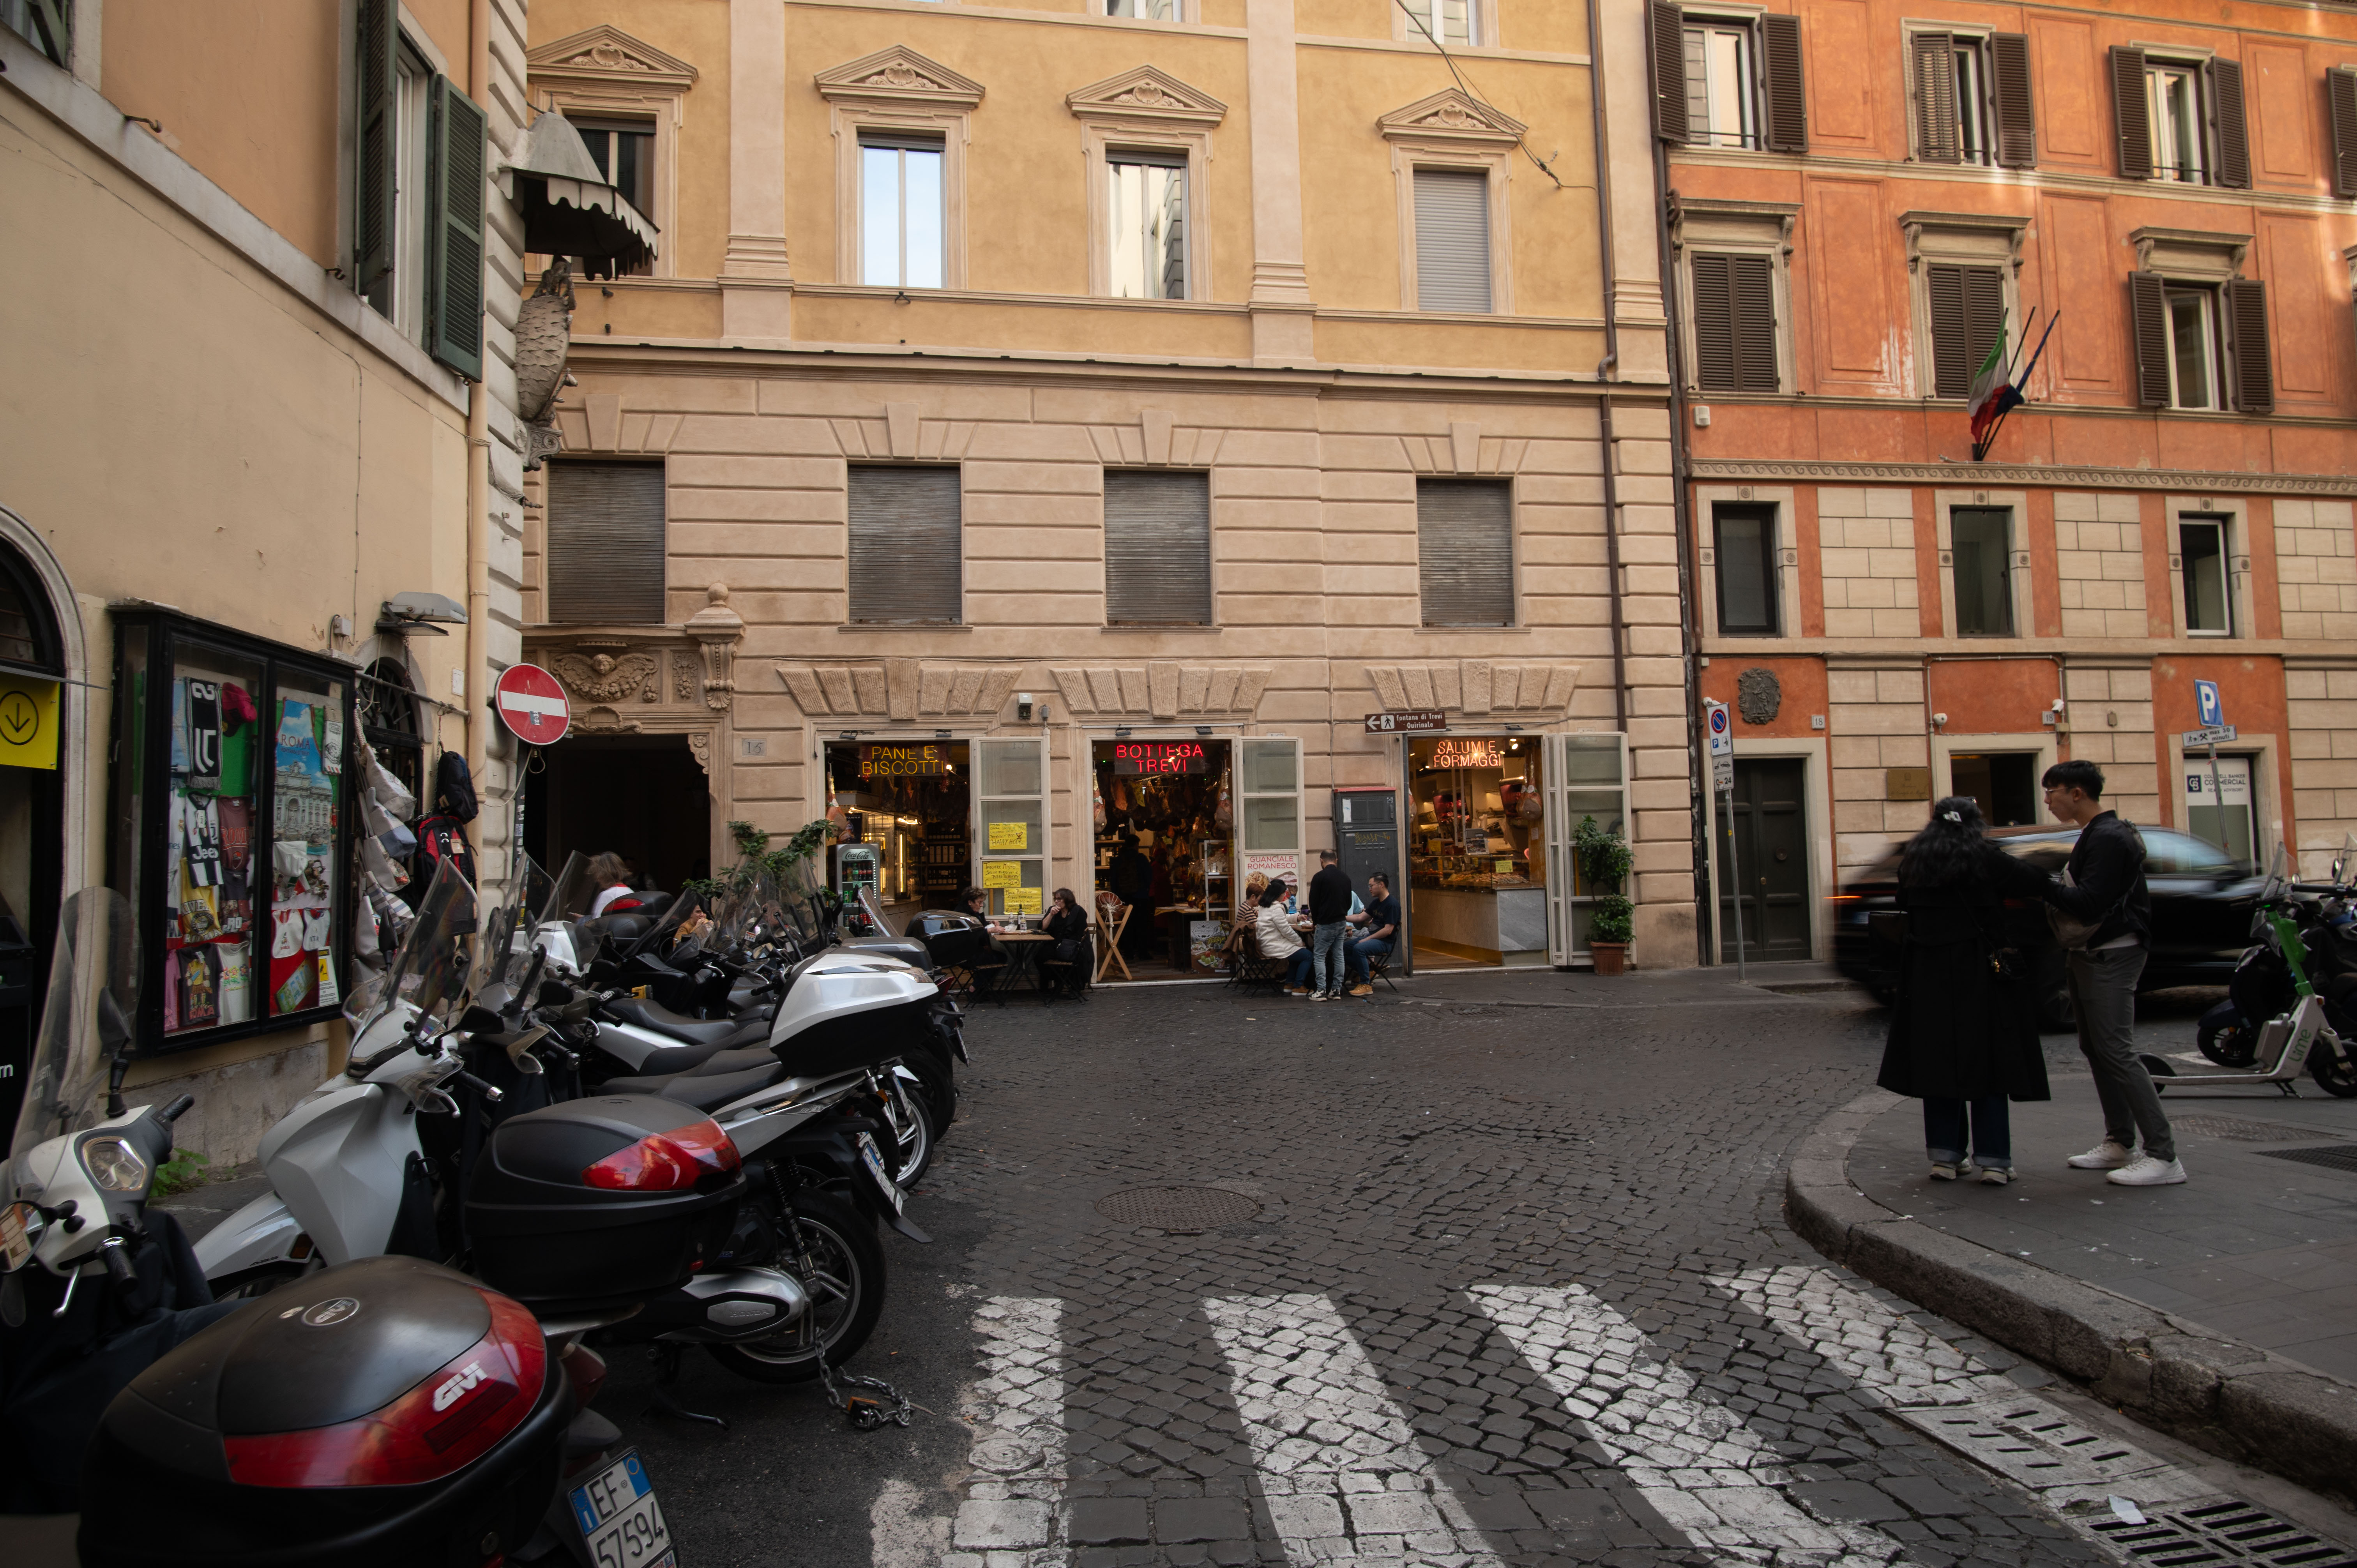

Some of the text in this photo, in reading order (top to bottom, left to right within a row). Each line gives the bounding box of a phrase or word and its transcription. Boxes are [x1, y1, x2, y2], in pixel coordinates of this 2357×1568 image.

[2199, 685, 2216, 721] P
[281, 734, 311, 749] ROMA
[748, 742, 763, 754] 15
[1437, 740, 1496, 754] SALUMI E
[872, 745, 935, 760] PANE E
[1116, 744, 1203, 758] BOTTEGA
[862, 760, 944, 775] BISCOTTI
[1135, 759, 1186, 773] TREVI
[1434, 753, 1501, 768] FORMAGGI
[845, 851, 870, 860] Coca-Cola
[2288, 1028, 2312, 1062] Lime
[730, 1309, 770, 1318] HONDA
[588, 1470, 618, 1519] EF
[596, 1500, 665, 1568] 57594
